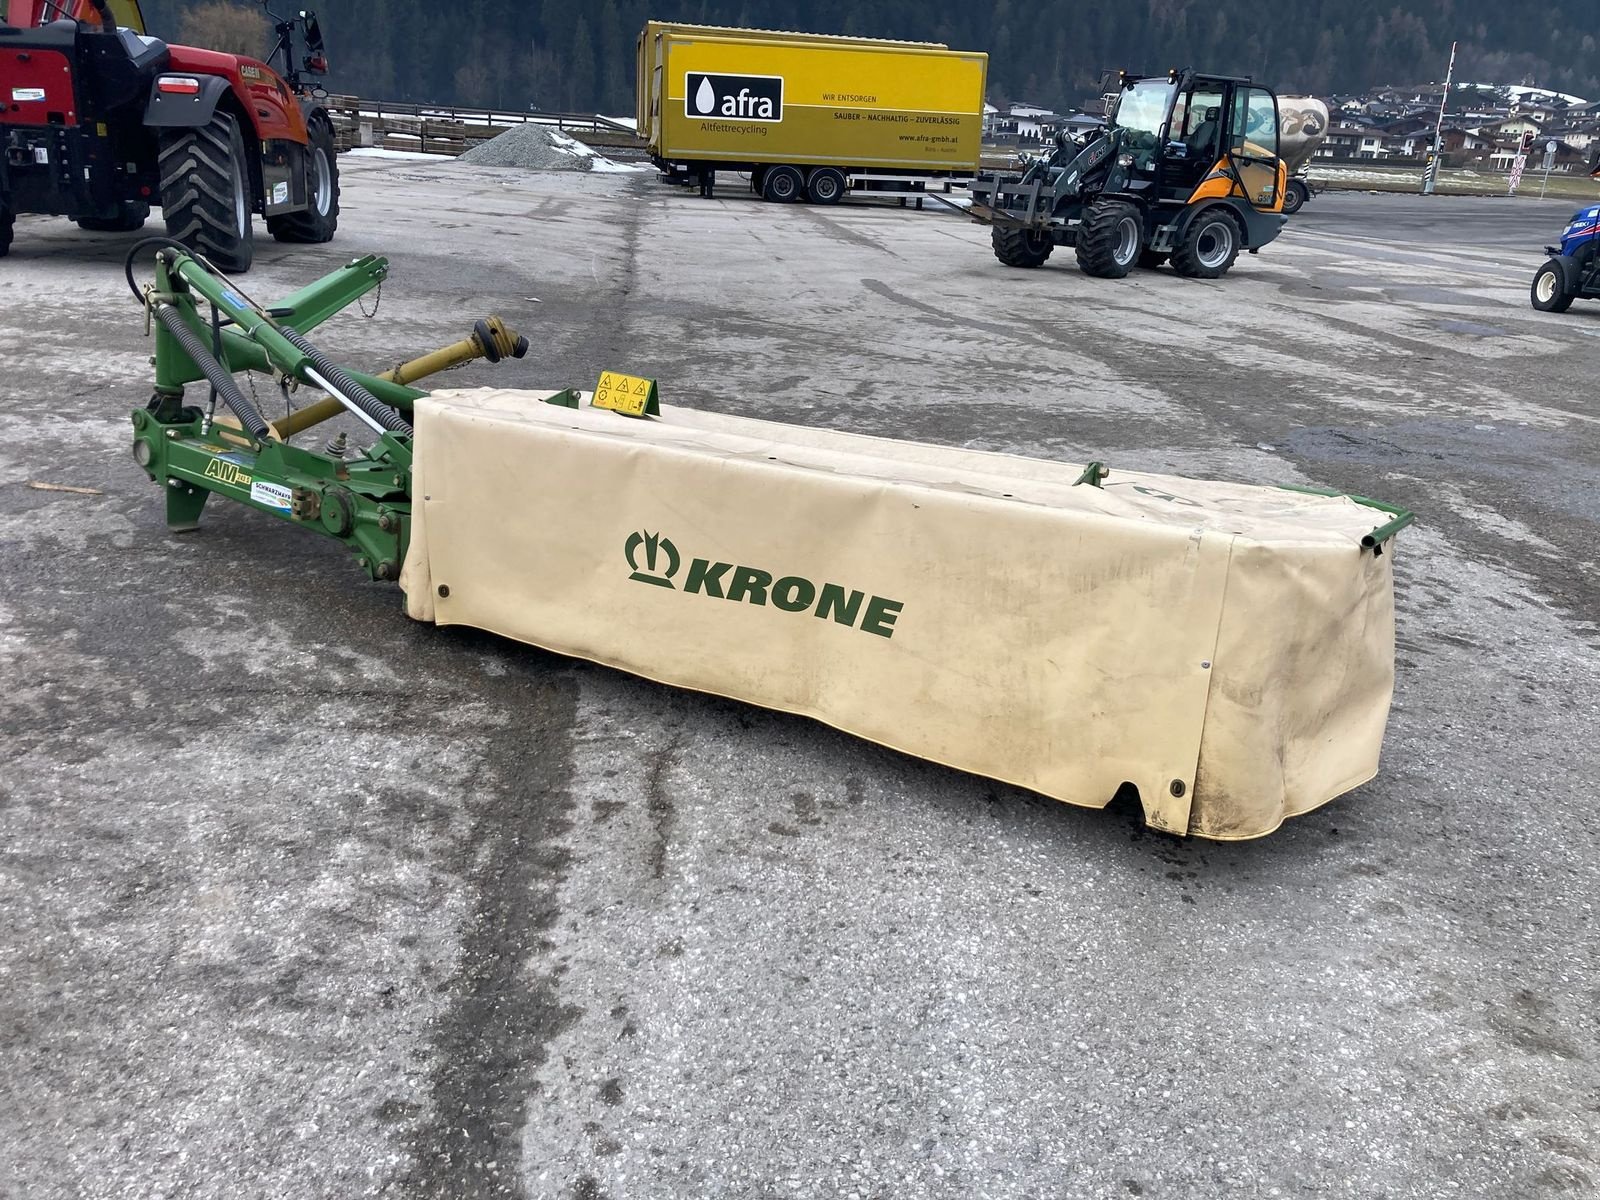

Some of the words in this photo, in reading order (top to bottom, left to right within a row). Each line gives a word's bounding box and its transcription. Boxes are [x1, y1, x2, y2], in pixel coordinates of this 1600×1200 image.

[721, 88, 773, 118] afra
[838, 94, 877, 103] ENTSORGEN
[834, 112, 861, 121] SAUBER
[868, 114, 909, 123] NACHHALTIG
[916, 115, 960, 125] ZUVERLÄSSIG
[700, 122, 768, 136] Altfettrecycling
[899, 134, 958, 144] www.afra-gmbh.at
[205, 458, 239, 484] AM
[683, 558, 904, 639] KRONE
